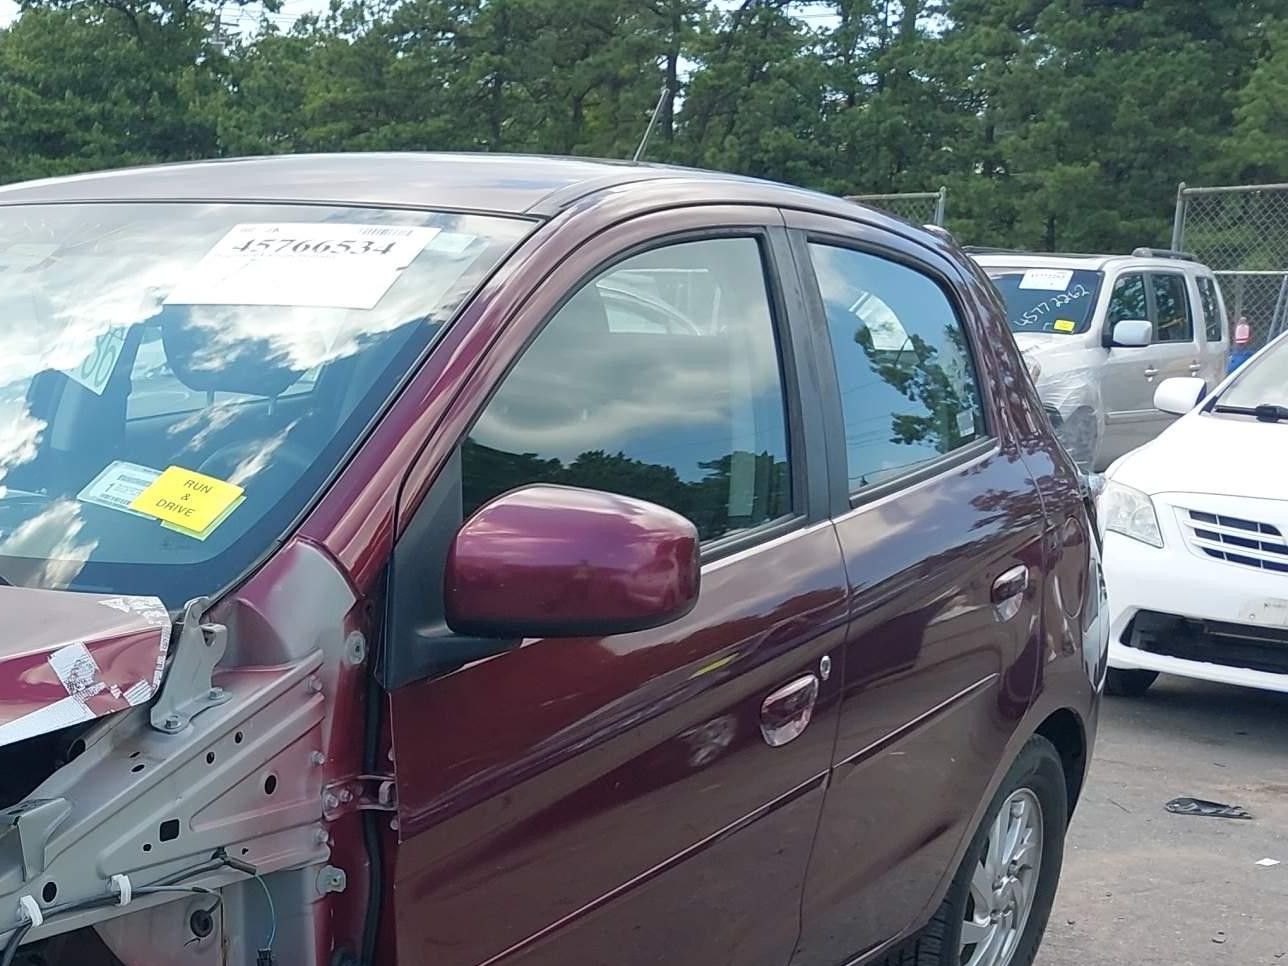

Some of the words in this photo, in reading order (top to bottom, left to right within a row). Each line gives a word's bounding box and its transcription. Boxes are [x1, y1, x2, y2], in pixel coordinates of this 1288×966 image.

[232, 238, 396, 254] 45766534
[183, 479, 213, 494] RUN
[180, 493, 191, 501] &
[155, 499, 196, 517] DRIVE
